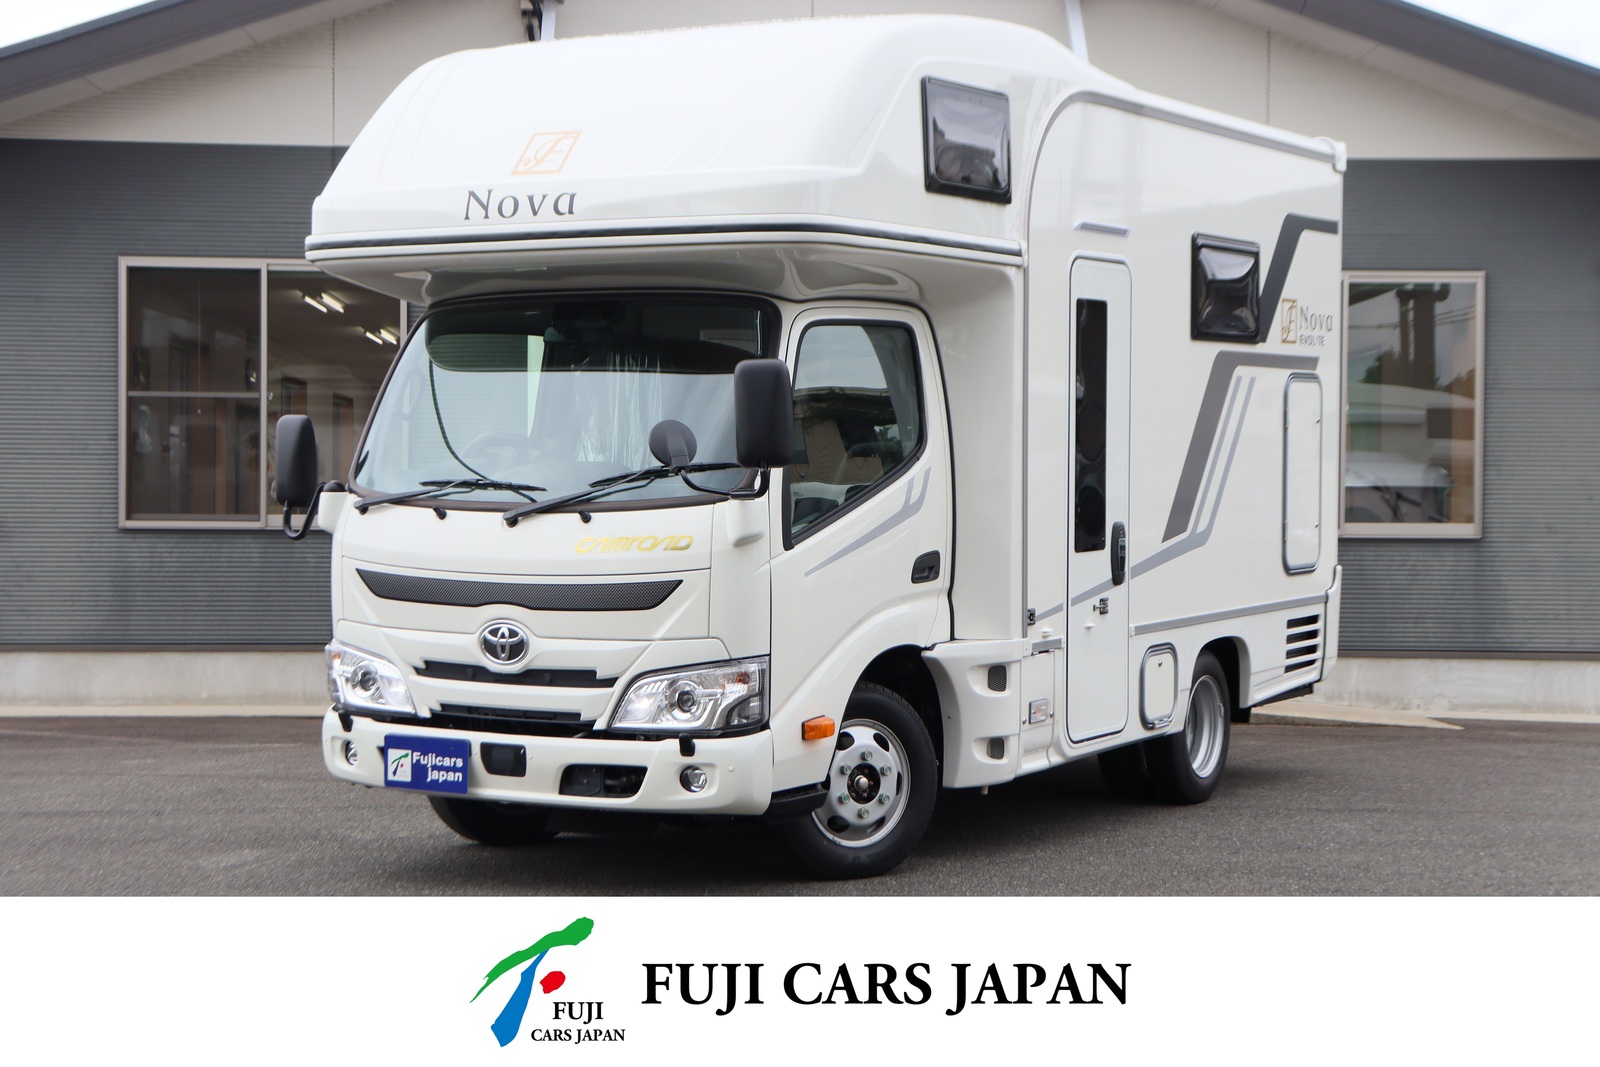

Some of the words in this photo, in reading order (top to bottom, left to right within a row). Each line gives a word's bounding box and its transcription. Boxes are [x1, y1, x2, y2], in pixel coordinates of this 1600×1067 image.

[464, 189, 577, 220] Nova
[1299, 305, 1333, 332] Nova
[412, 751, 464, 768] Fujicars
